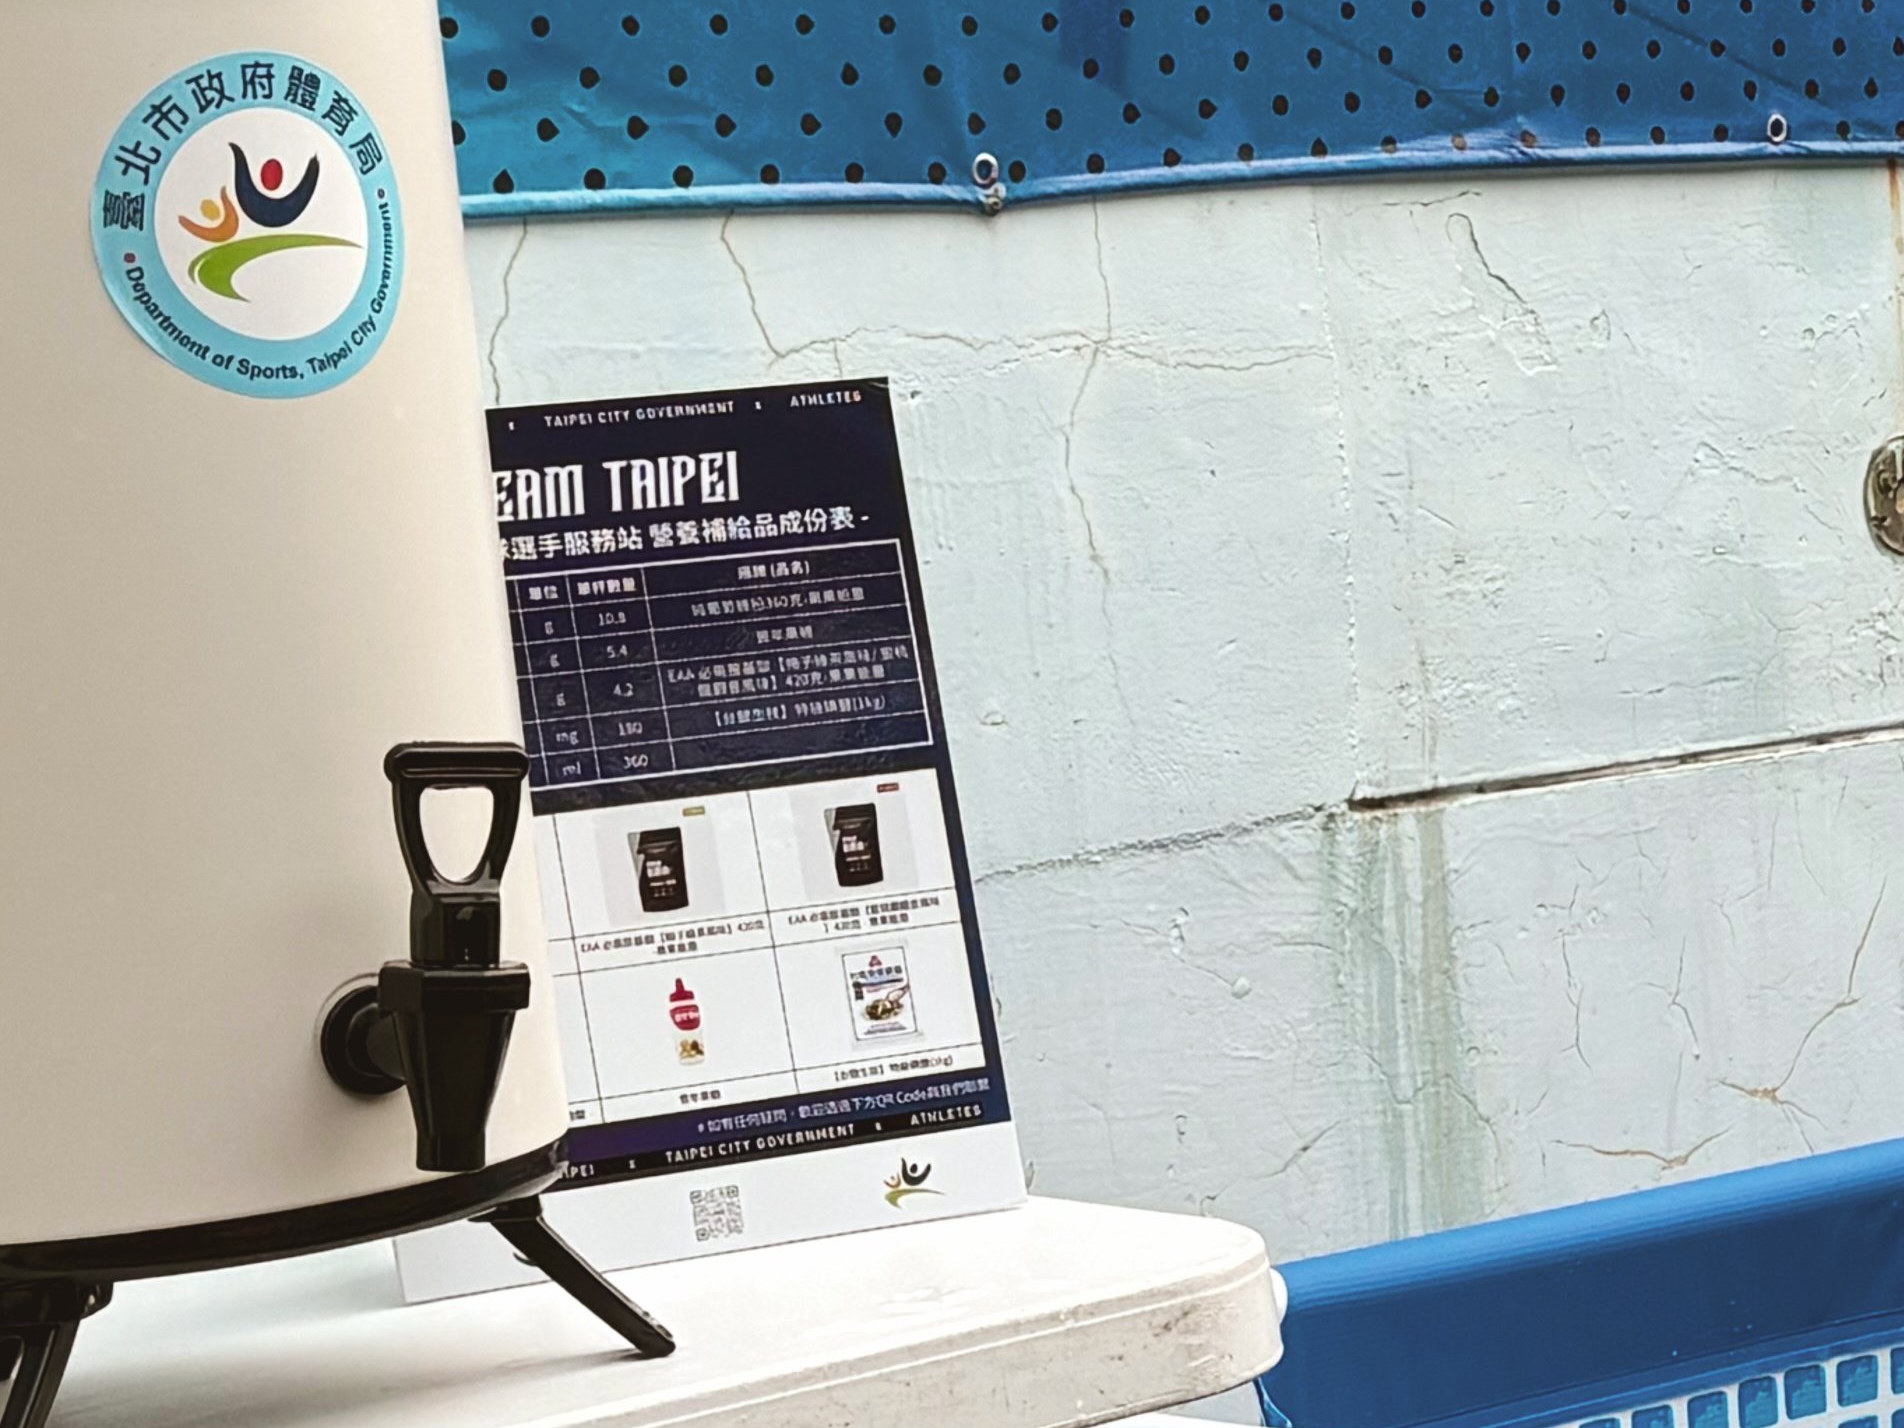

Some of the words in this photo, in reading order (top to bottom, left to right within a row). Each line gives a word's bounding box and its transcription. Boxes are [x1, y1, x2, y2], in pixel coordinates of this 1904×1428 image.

[103, 60, 383, 231] 臺北市政府體育局
[124, 267, 210, 360] Department
[212, 353, 233, 371] of
[236, 358, 304, 380] Sports,
[306, 343, 353, 375] Taipei
[350, 317, 377, 347] City
[370, 202, 394, 314] Government
[544, 412, 593, 427] TAIPEI
[598, 409, 630, 423] CITY
[636, 401, 734, 420] GOVERNMENT
[790, 390, 861, 408] ATHLETES
[602, 450, 739, 512] TAIPEI
[666, 1145, 714, 1165] TAIPEI
[718, 1138, 750, 1158] CITY
[756, 1123, 855, 1152] GOVERNMENT
[910, 1104, 981, 1126] ATHLETES
